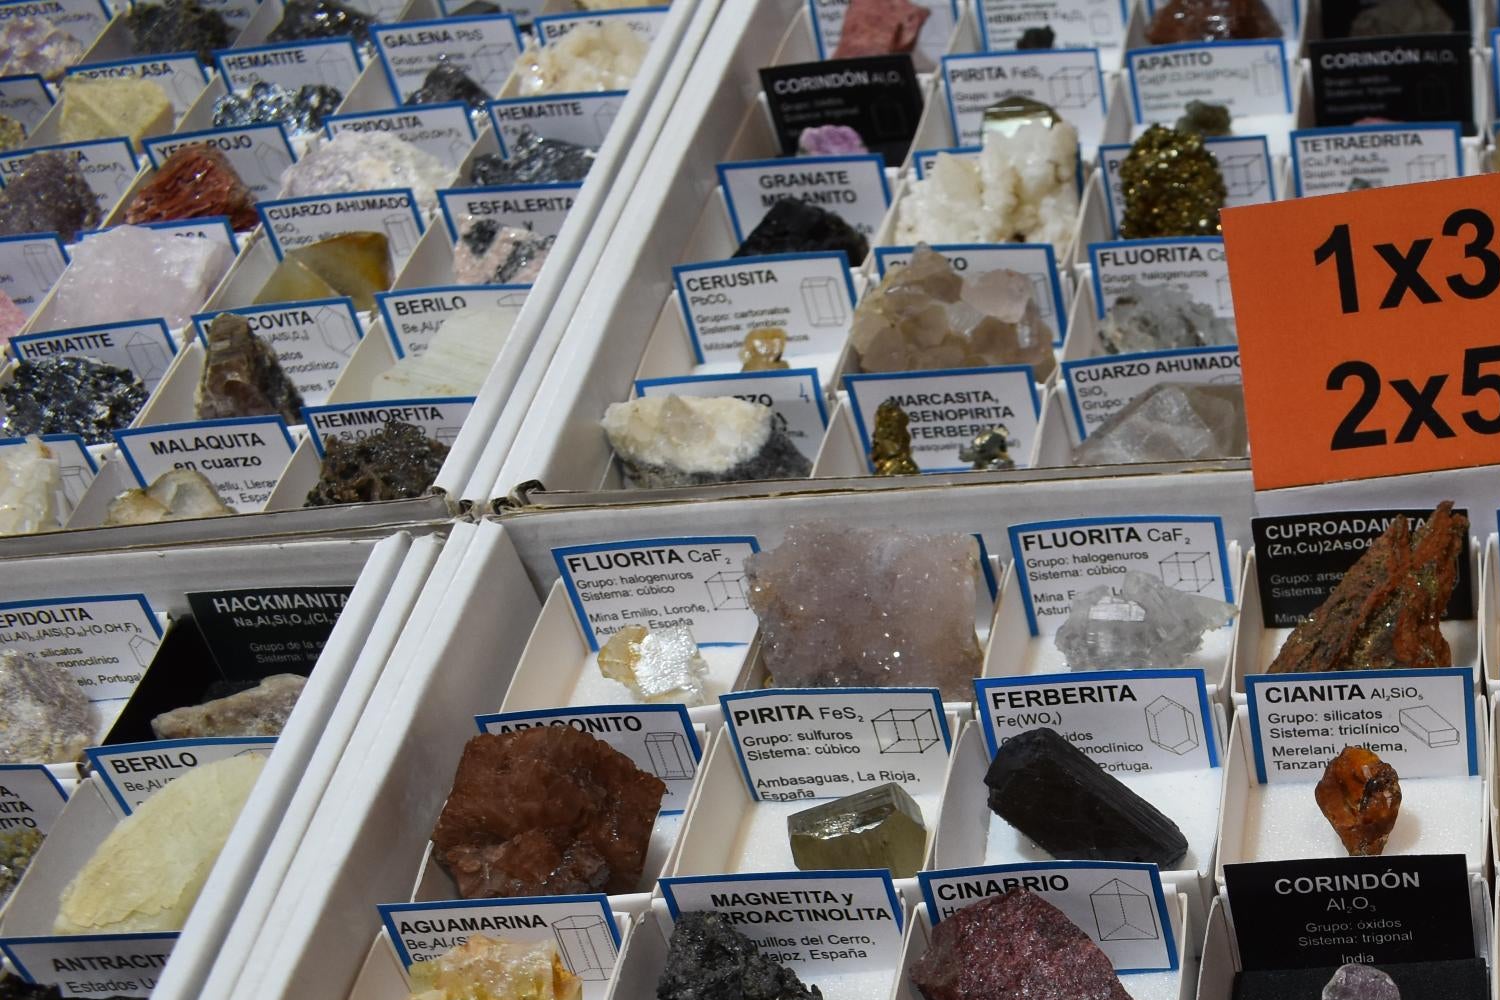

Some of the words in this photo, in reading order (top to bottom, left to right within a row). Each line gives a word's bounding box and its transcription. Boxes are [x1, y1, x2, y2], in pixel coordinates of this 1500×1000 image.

[383, 29, 451, 49] GALENA
[225, 51, 306, 70] HEMATITE
[1137, 52, 1213, 70] APATITO
[1320, 47, 1420, 69] CORINDÓN
[774, 70, 869, 95] CORINDÓN
[950, 67, 1006, 83] PIRITA
[499, 102, 583, 121] HEMATITE
[1301, 133, 1423, 152] TETRAEDRITA
[759, 171, 849, 189] GRANATE
[268, 203, 332, 220] CUARZO
[336, 196, 411, 213] AHUMADO
[467, 197, 573, 215] ESFALERITA
[761, 190, 857, 207] MELANITO
[1100, 247, 1202, 267] FLUORITA
[686, 269, 778, 292] CERUSITA
[22, 333, 115, 358] HEMATITE
[1075, 362, 1150, 383] CUARZO
[314, 407, 444, 429] HEMIMORFITA
[910, 406, 1014, 423] SENOPIRITA
[150, 433, 265, 455] MALAQUITA
[201, 456, 262, 471] cuarzo
[1022, 526, 1142, 551] FLUORITA
[567, 549, 684, 573] FLUORITA
[1027, 556, 1069, 570] Grupo:
[1072, 550, 1149, 566] halogenuros
[576, 577, 618, 590] Grupo:
[621, 570, 694, 585] halogenuros
[581, 589, 633, 602] Sistema:
[637, 583, 675, 595] cúbico
[212, 594, 350, 614] HACKMANITA
[590, 609, 619, 622] Mina
[622, 606, 660, 620] Emilio,
[663, 601, 710, 617] Loroñe,
[0, 607, 94, 629] EPIDOLITA
[991, 684, 1138, 710] FERBERITA
[1265, 684, 1365, 704] CIANITA
[734, 704, 814, 727] PIRITA
[1267, 712, 1319, 725] Grupo:
[1323, 709, 1383, 721] silicatos
[743, 734, 793, 748] Grupo:
[797, 730, 853, 742] sulfuros
[1270, 726, 1336, 739] Sistema:
[1338, 722, 1400, 736] triclínico
[110, 752, 198, 774] BERILO
[756, 771, 853, 790] Ambasaguas,
[857, 771, 877, 782] La
[880, 769, 921, 784] Rioja,
[937, 874, 1069, 900] CINABRIO
[1274, 868, 1421, 896] CORINDÓN
[711, 890, 835, 908] MAGNETITA
[842, 892, 853, 905] y
[400, 914, 548, 935] AGUAMARINA
[1305, 920, 1353, 934] Grupo:
[1357, 917, 1402, 930] óxidos
[1298, 933, 1358, 947] Sistema:
[1362, 930, 1413, 945] trigonal
[53, 954, 169, 972] ANTRACIT
[1341, 952, 1375, 965] India
[66, 976, 138, 994] Estados
